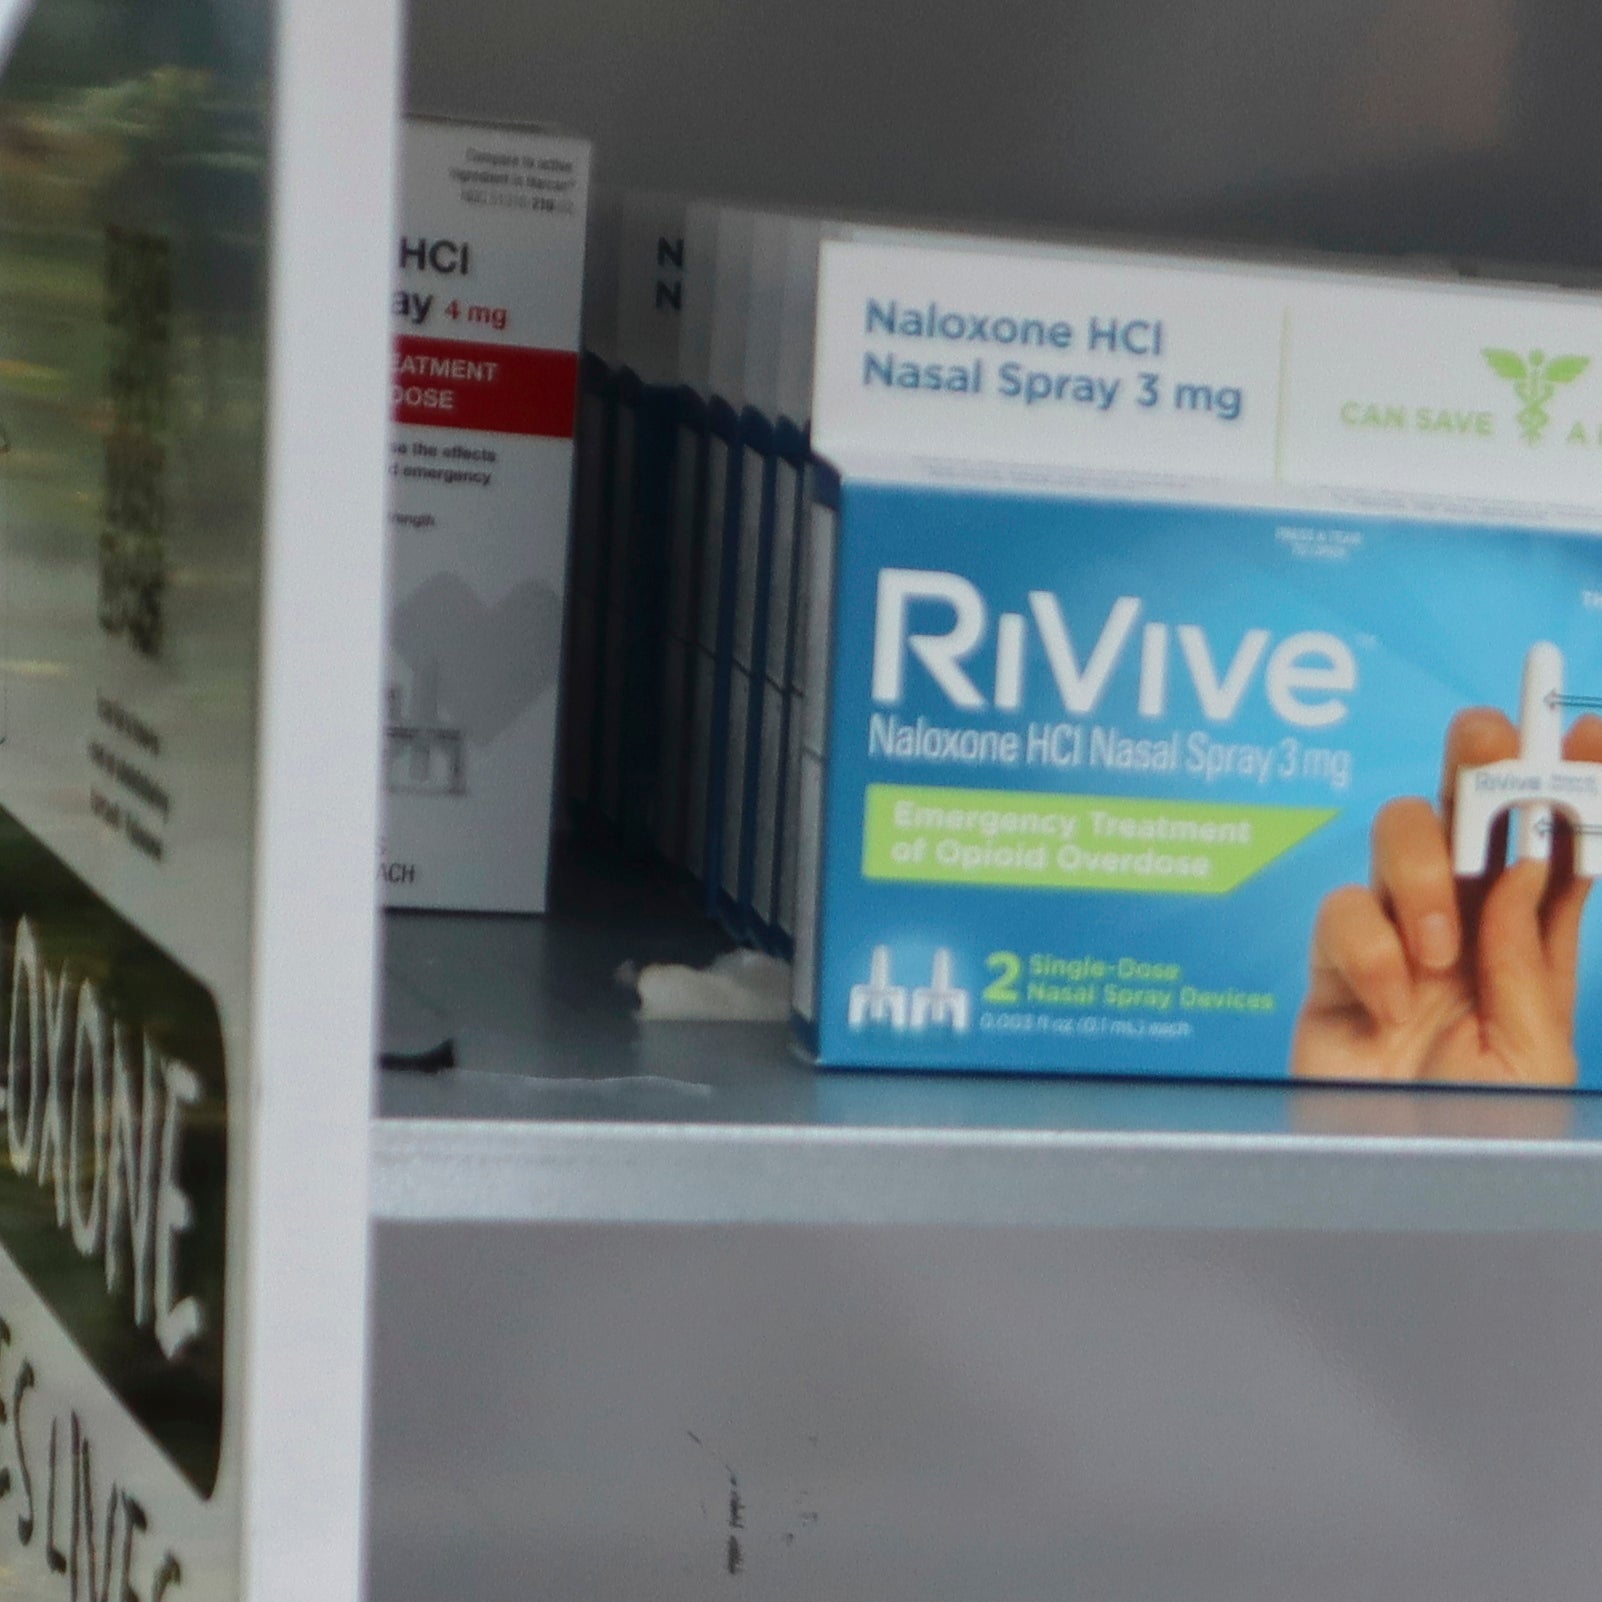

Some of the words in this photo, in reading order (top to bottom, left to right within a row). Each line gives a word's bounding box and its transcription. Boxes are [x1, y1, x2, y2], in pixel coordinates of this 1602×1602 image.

[400, 237, 469, 275] HCl
[444, 300, 460, 320] 4
[467, 304, 508, 330] mg
[864, 297, 1072, 349] Naloxone
[1088, 316, 1163, 356] HCl
[862, 351, 982, 393] Nasal
[999, 361, 1119, 411] Spray
[1138, 373, 1159, 407] 3
[1175, 383, 1242, 420] mg
[1340, 401, 1404, 429] CAN
[1416, 407, 1493, 436] SAVE
[1567, 421, 1587, 445] A
[403, 466, 491, 486] emergency
[871, 568, 1359, 727] RiVive
[868, 712, 1018, 764] Naloxone
[1027, 721, 1081, 766] HCl
[1090, 724, 1178, 771] Nasal
[1185, 730, 1272, 785] Spray
[1277, 737, 1298, 778] 3
[1302, 749, 1352, 789] mg
[894, 800, 1077, 840] Emergency
[1089, 811, 1252, 845] Treatment
[891, 838, 928, 864] of
[935, 840, 1047, 875] Opioid
[1056, 845, 1210, 879] Overdose
[982, 951, 1022, 1004] 2
[1028, 953, 1181, 981] Single-Dose
[1027, 983, 1095, 1004] Nasal
[1103, 983, 1173, 1010] Spray
[1180, 985, 1274, 1011] Devices
